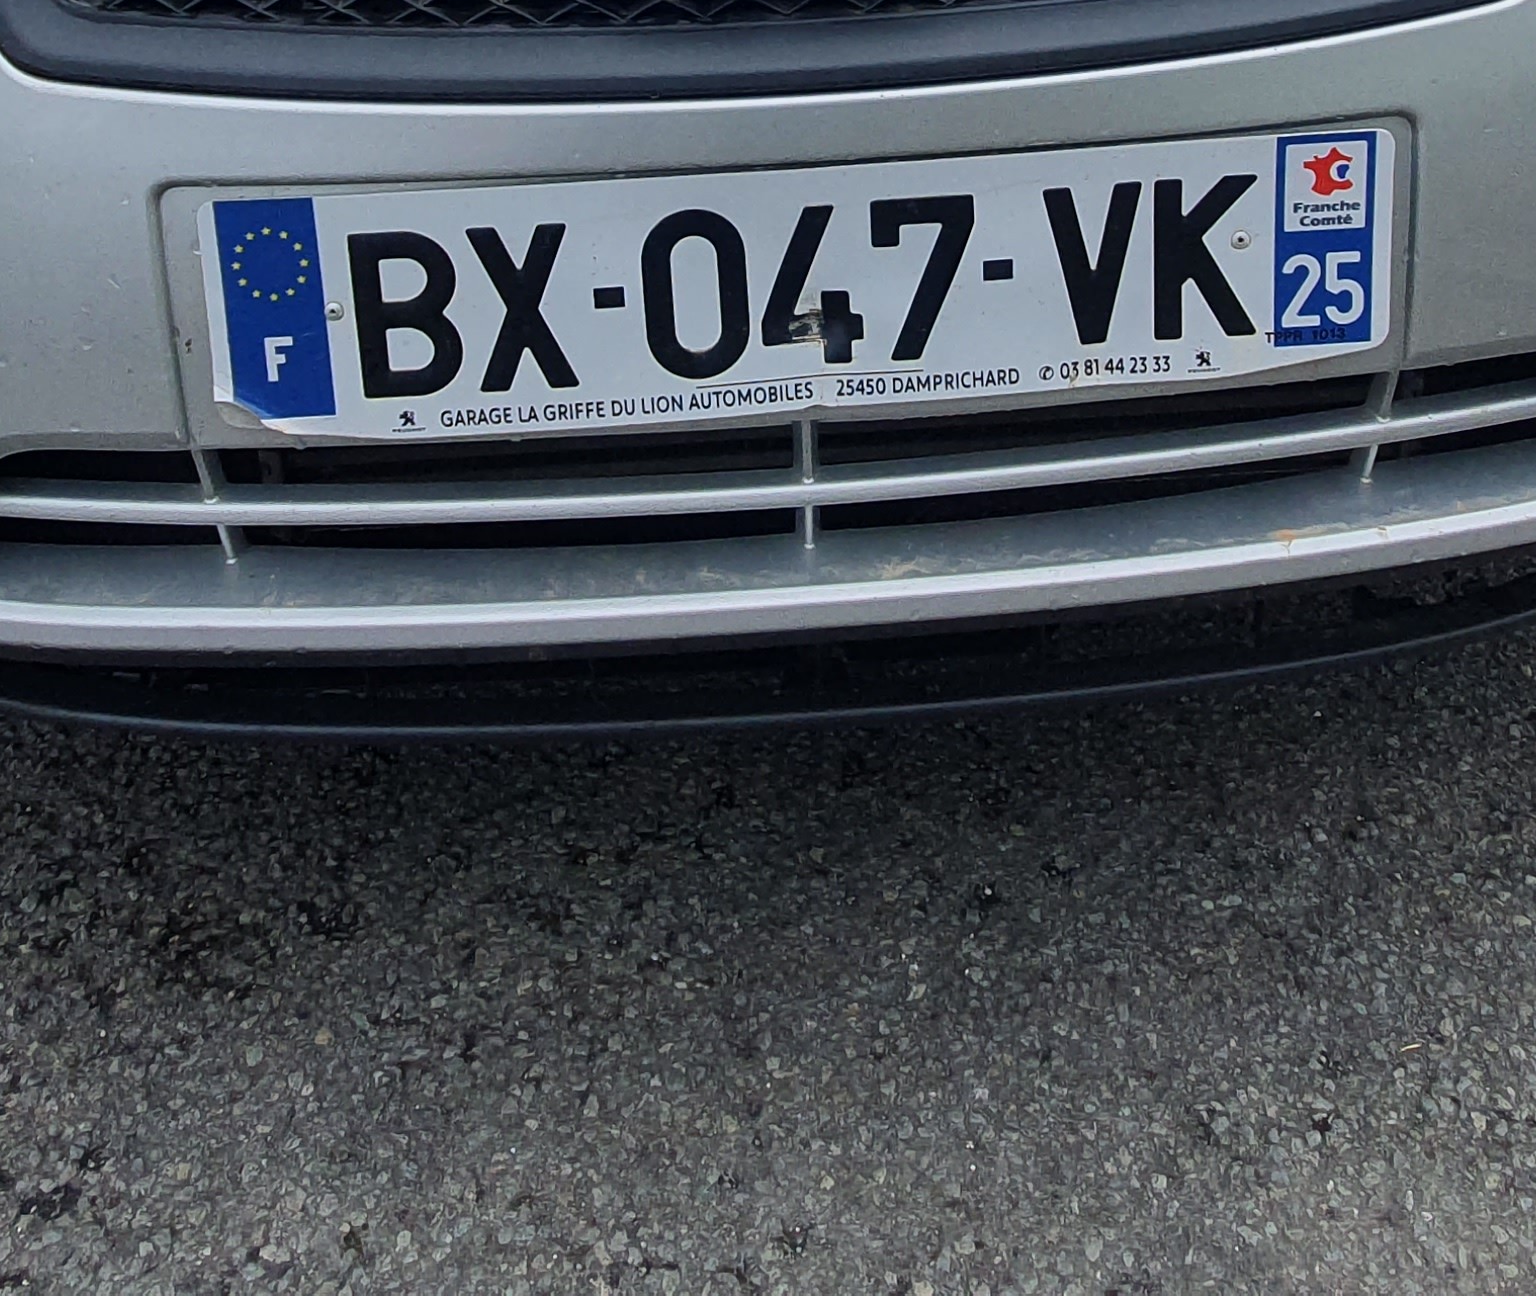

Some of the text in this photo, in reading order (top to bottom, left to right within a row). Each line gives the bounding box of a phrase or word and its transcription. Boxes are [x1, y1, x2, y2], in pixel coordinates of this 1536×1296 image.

[1293, 201, 1361, 214] Franche
[1299, 214, 1354, 227] Comté
[347, 173, 1258, 399] BX-047-VK
[1281, 251, 1365, 329] 25
[264, 336, 294, 383] F
[440, 355, 1171, 428] GARAGE LA GRIFFE DU LION AUTOMOBILES 25450 DAMPRICHARD 03 81 44 23 33
